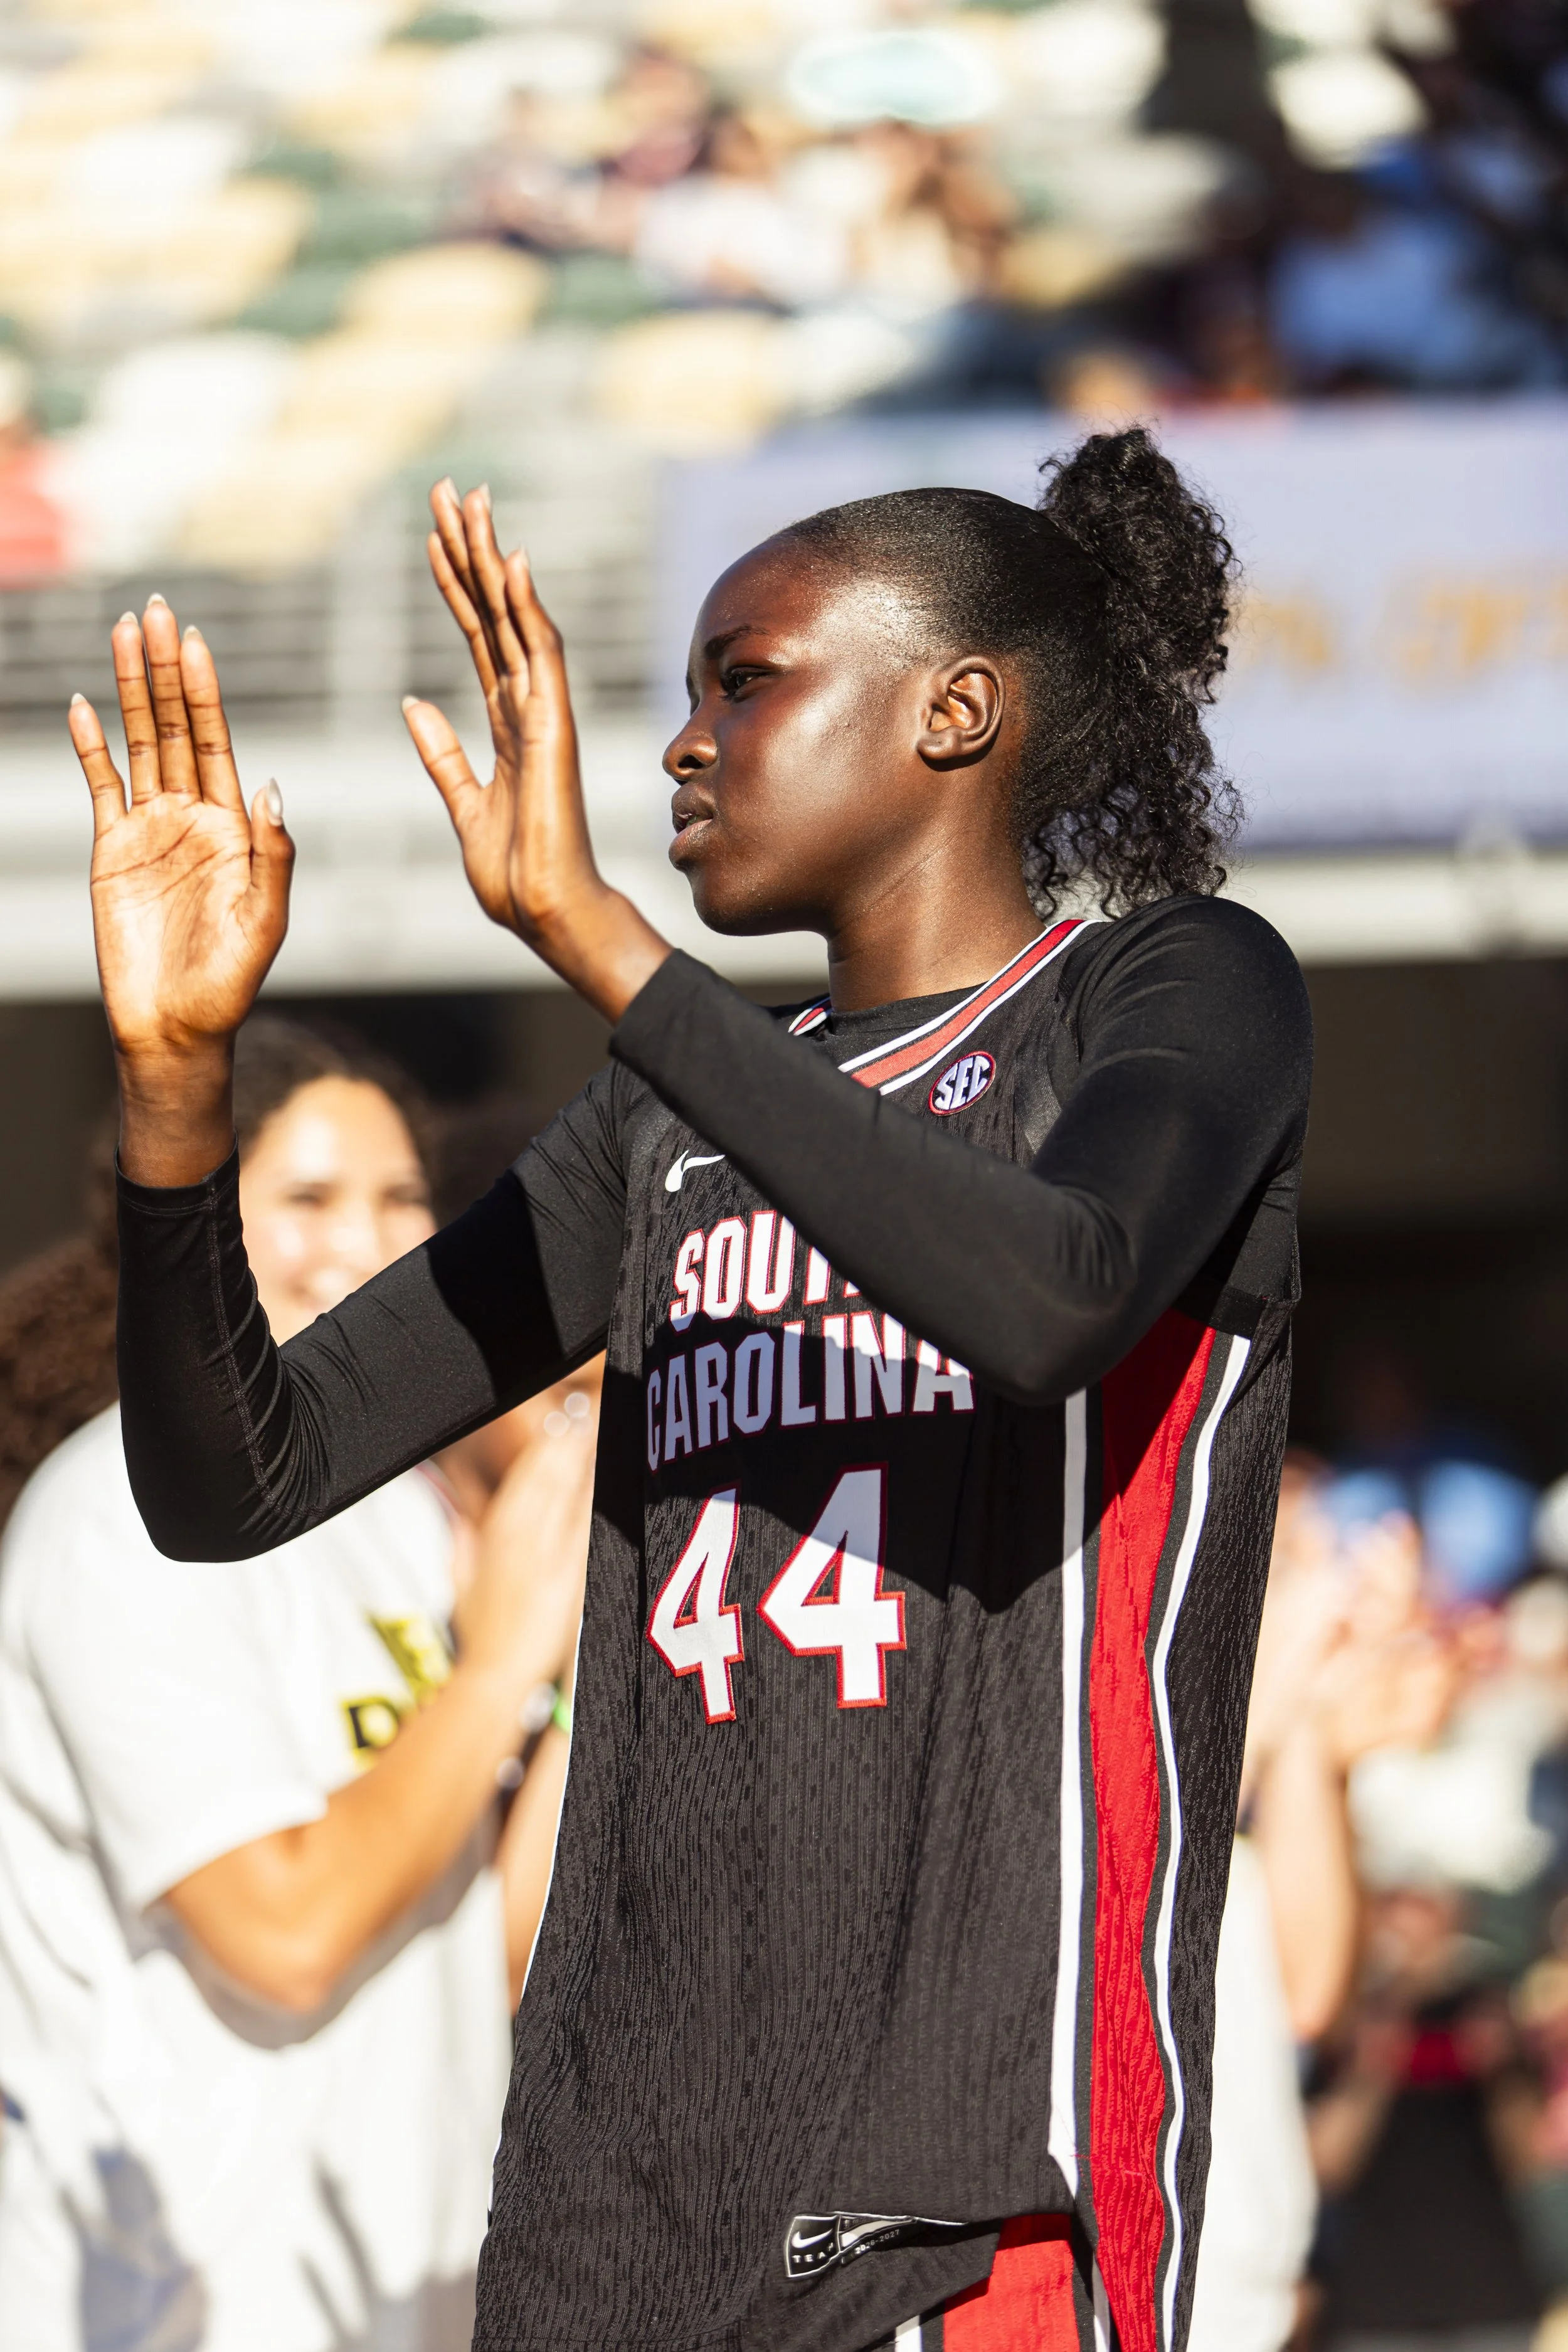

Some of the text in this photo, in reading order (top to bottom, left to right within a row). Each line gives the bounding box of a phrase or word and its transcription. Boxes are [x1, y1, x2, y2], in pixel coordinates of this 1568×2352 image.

[934, 1056, 990, 1110] SEC
[669, 1210, 862, 1334] SOU
[647, 1311, 975, 1474] CAROLINA
[646, 1462, 907, 1724] 44
